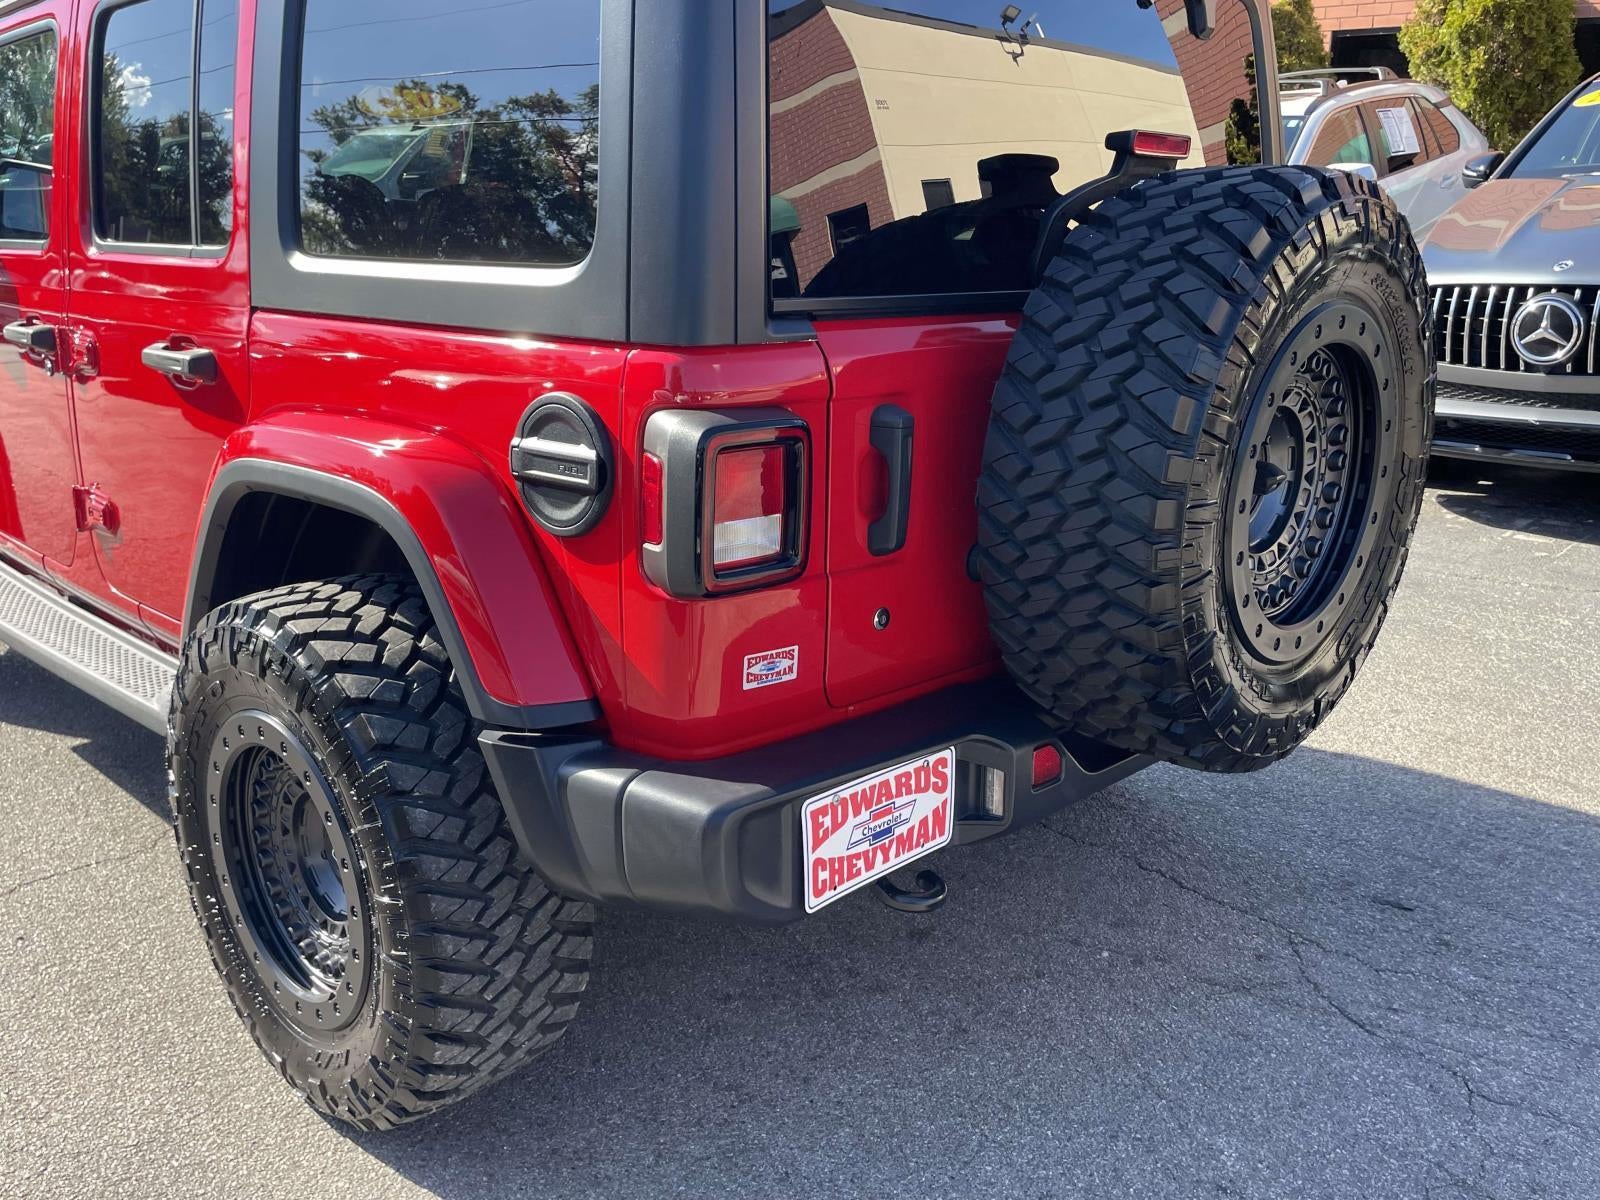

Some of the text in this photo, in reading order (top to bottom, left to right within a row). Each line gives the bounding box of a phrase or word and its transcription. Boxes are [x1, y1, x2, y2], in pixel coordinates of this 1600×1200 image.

[557, 464, 583, 476] FUEL
[747, 649, 795, 670] EDWARDS
[746, 662, 795, 684] CHEVYMAN
[810, 756, 949, 854] EDWARDS
[861, 812, 902, 837] Chevrolet
[812, 797, 948, 899] CHEVYMAN
